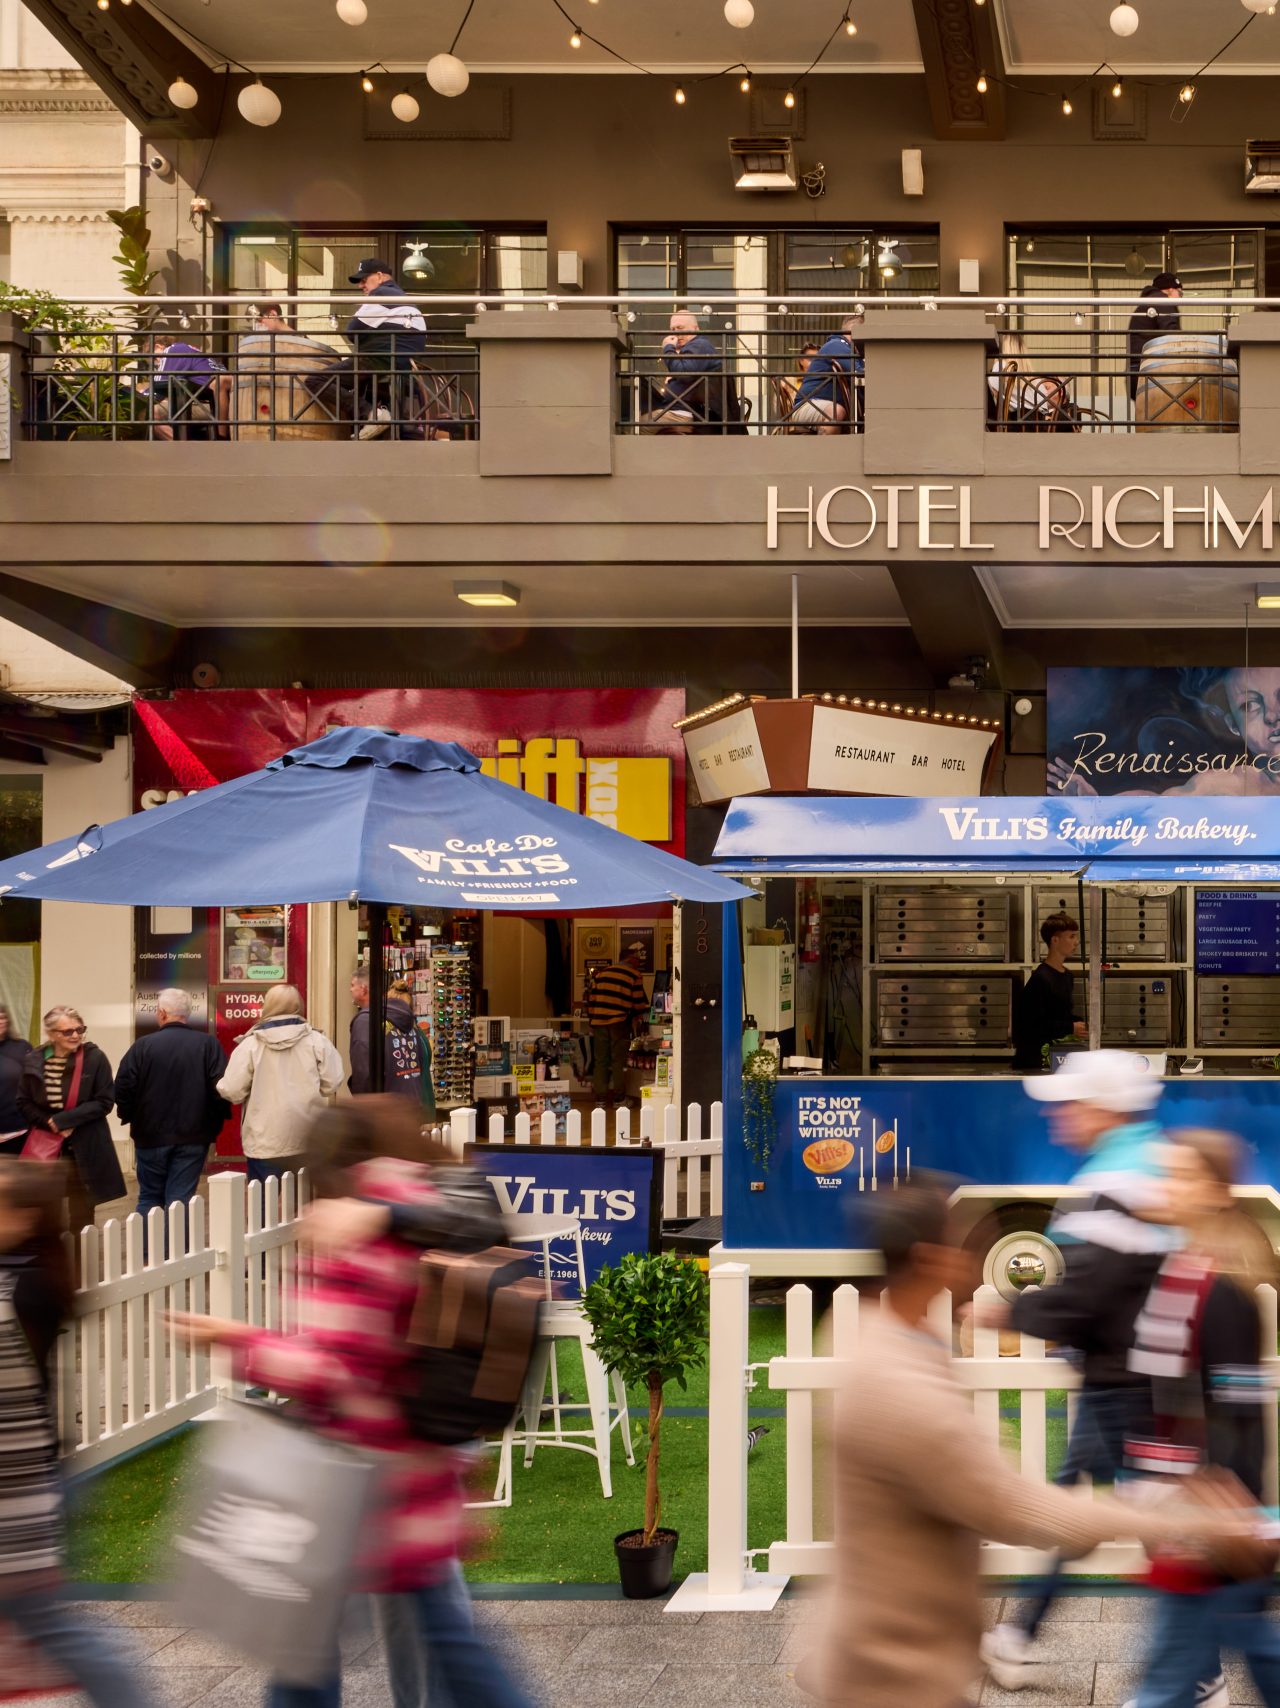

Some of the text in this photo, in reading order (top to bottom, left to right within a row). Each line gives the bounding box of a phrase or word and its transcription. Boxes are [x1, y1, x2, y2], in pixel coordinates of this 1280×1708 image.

[766, 485, 994, 549] HOTEL
[835, 745, 966, 772] RESTAURANT BAR HOTEL
[939, 808, 1257, 846] VILI'S Family Bakery.
[445, 834, 558, 857] Cafe De
[388, 844, 570, 876] VILI'S
[417, 877, 465, 888] FAMILY
[168, 953, 176, 961] by
[226, 1009, 263, 1018] BOOST
[799, 1097, 861, 1109] IT'S NOT
[799, 1110, 861, 1125] FOOTY
[798, 1127, 861, 1138] WITHOUT
[486, 1176, 636, 1221] VILI'S
[560, 1227, 612, 1245] kery
